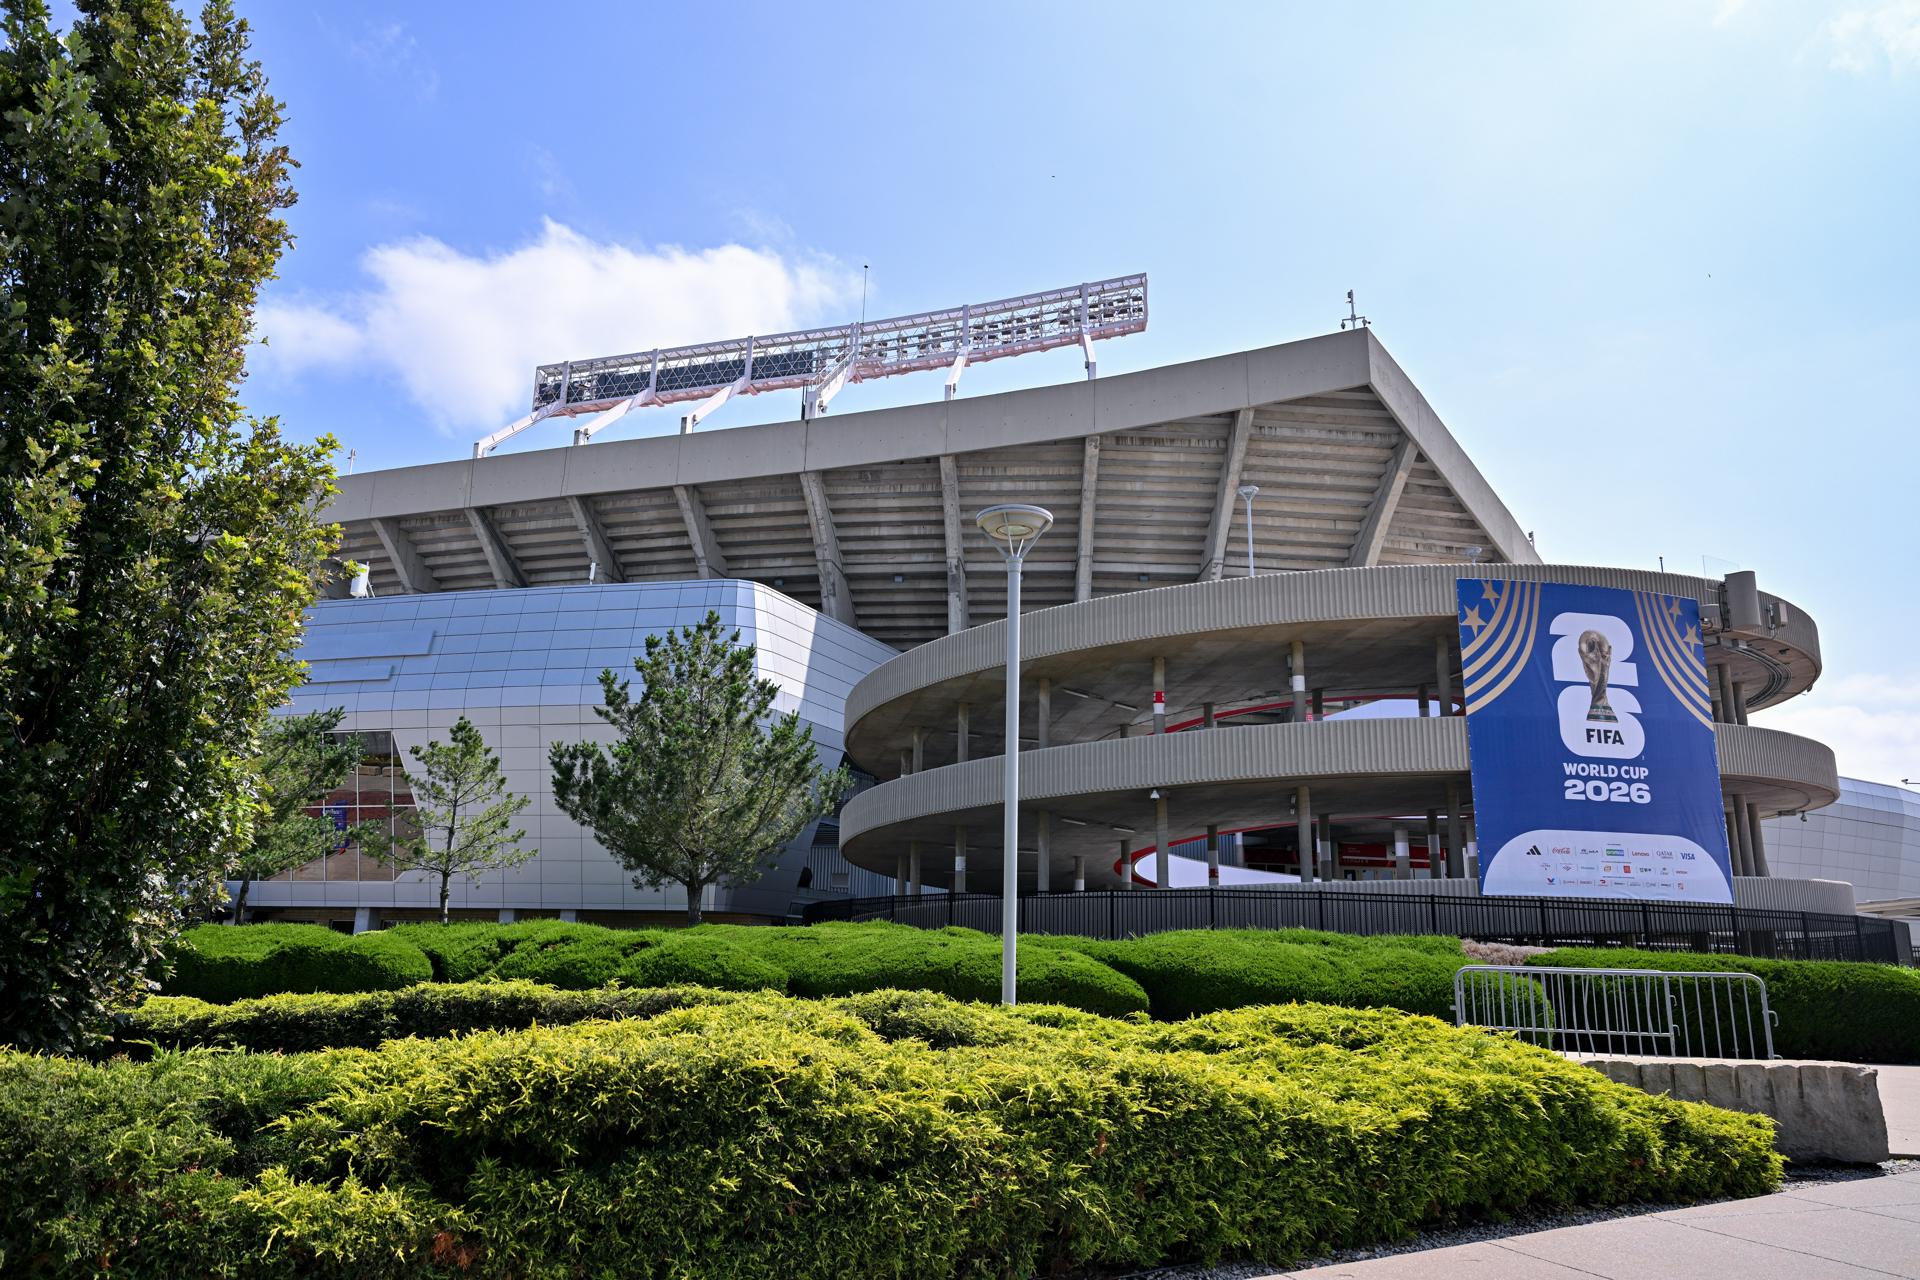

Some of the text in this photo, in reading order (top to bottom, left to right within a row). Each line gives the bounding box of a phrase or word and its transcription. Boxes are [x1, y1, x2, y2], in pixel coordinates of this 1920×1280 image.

[1585, 728, 1625, 745] FIFA
[1562, 762, 1649, 780] WORLD CUP
[1563, 779, 1652, 804] 2026
[1680, 852, 1696, 860] VISA
